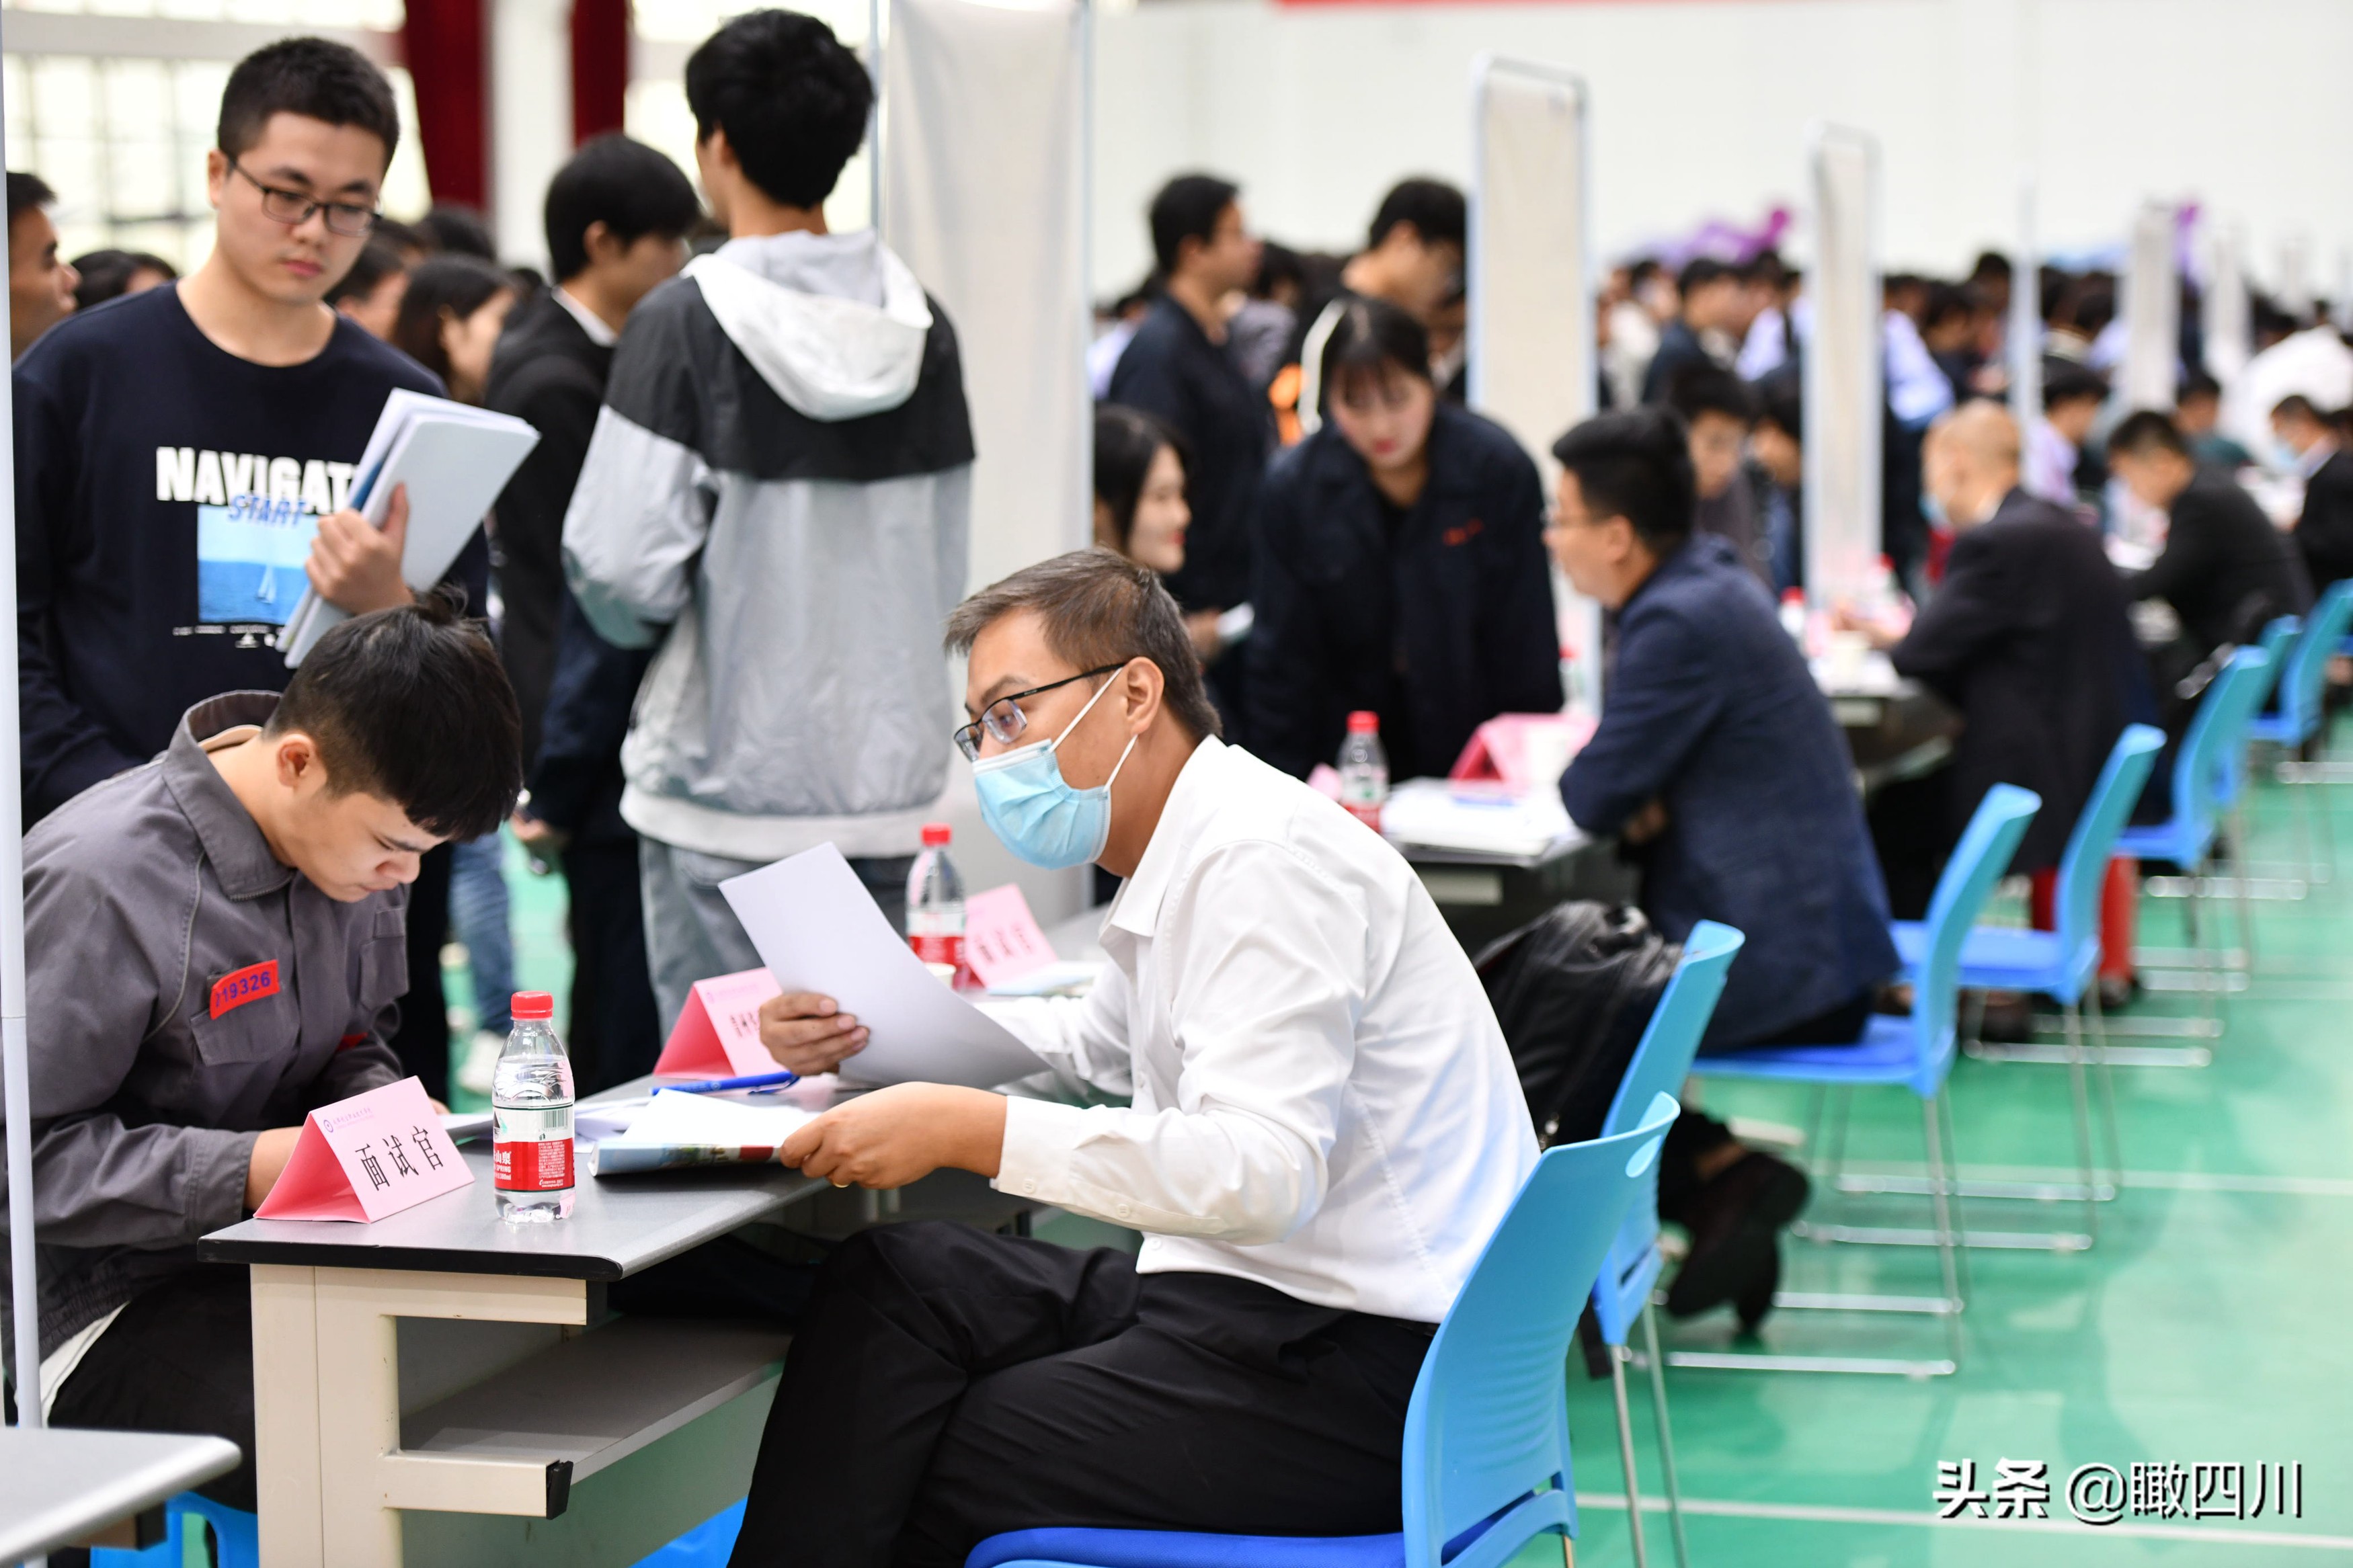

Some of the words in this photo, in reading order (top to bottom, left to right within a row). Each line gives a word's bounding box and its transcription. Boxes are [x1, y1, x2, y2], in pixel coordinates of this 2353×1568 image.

[156, 446, 357, 515] NAVIGAT
[228, 495, 307, 527] START
[355, 1125, 444, 1191] 面试官
